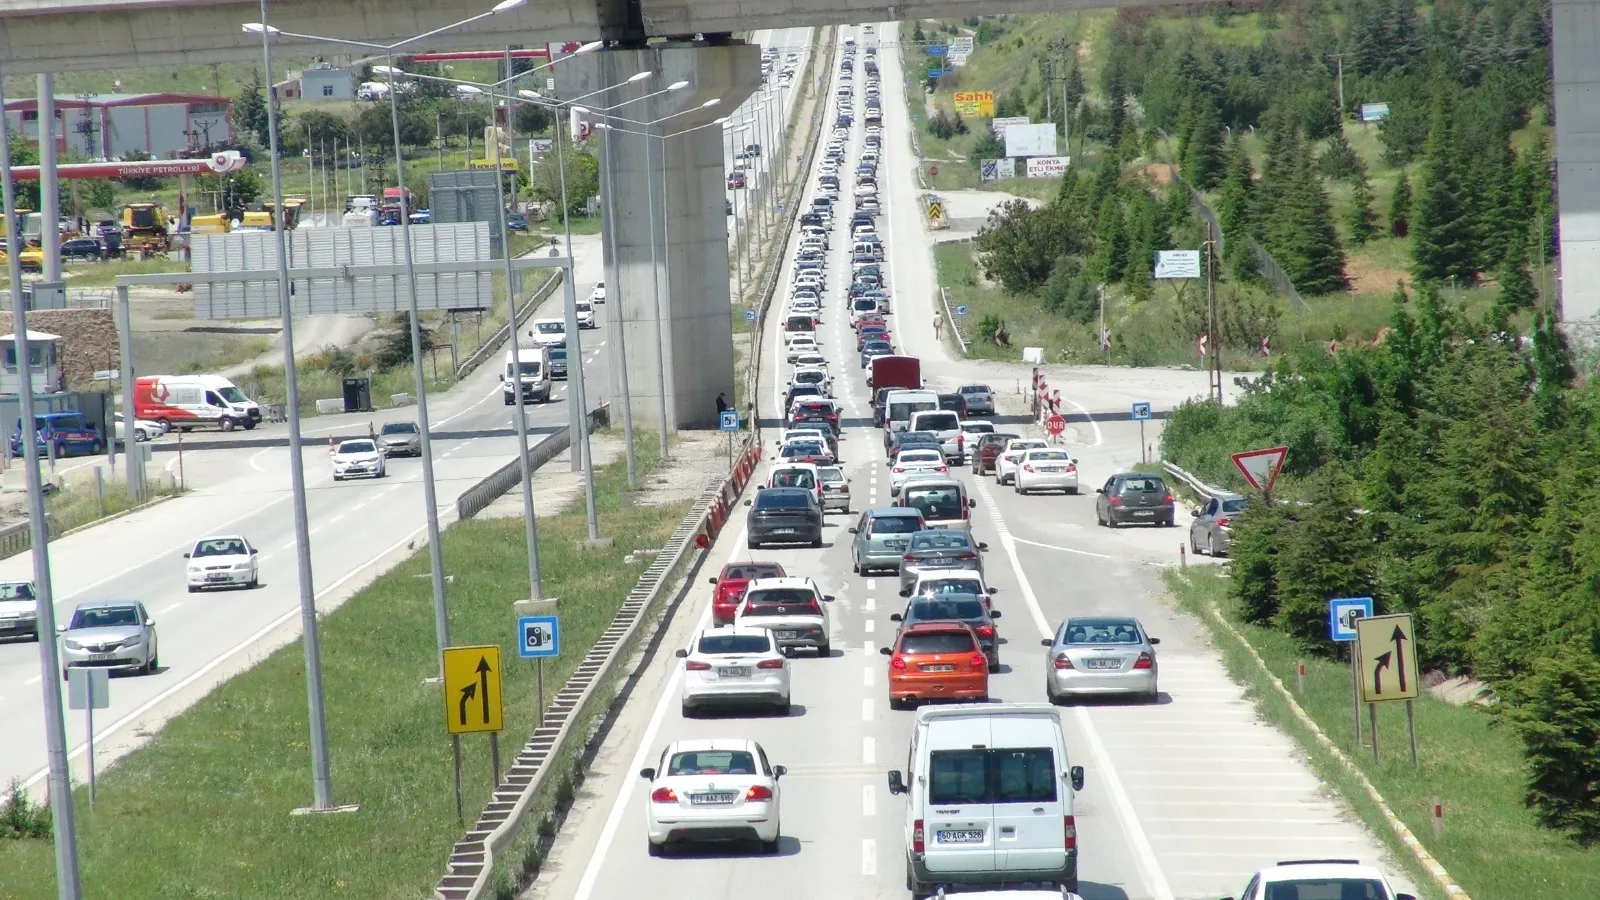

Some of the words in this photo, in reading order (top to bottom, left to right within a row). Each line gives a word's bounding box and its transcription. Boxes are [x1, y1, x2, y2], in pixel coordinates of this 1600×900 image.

[118, 167, 151, 175] TÜRKİYE
[153, 164, 200, 173] PETROLLERİ
[1047, 421, 1064, 429] DUR
[953, 831, 967, 839] AGK
[968, 831, 982, 839] 526
